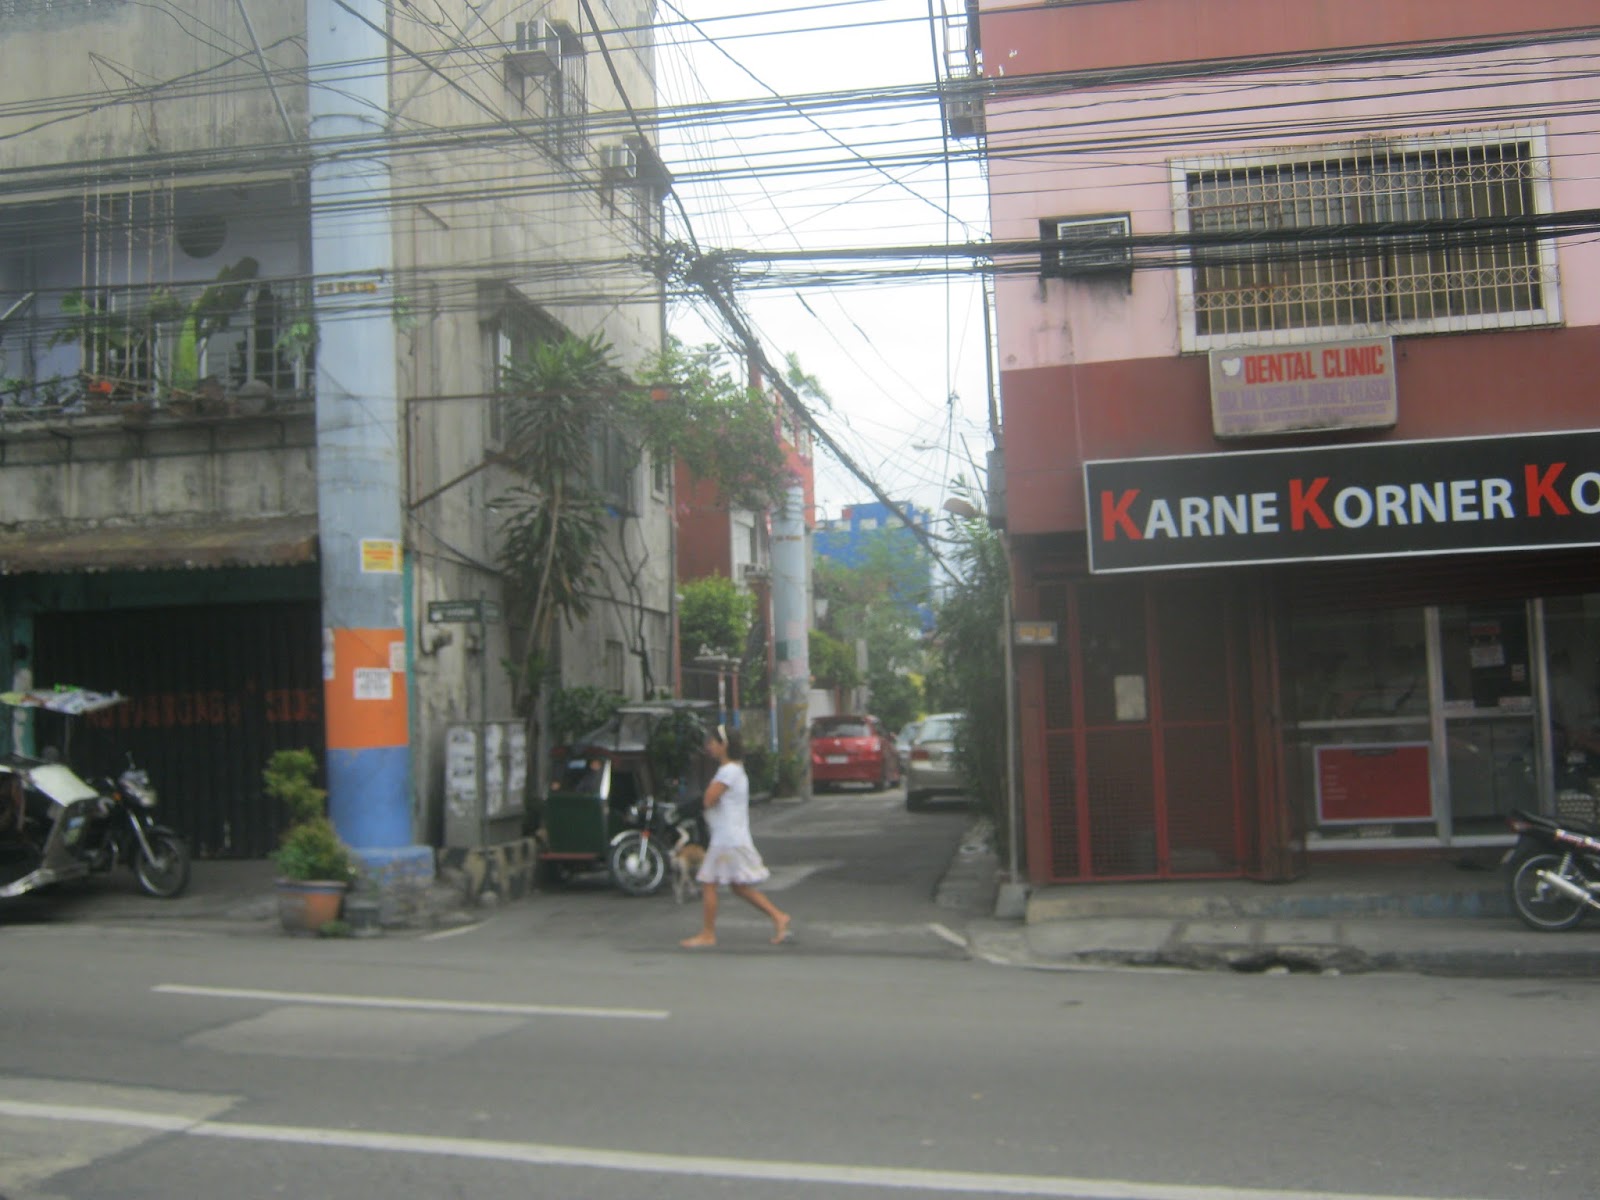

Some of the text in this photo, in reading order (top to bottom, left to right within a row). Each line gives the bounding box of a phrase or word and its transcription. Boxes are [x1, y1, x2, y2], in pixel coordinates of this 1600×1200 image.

[1244, 345, 1384, 384] DENTAL CLINIC
[1100, 488, 1280, 541] KARNE
[1289, 476, 1515, 531] KORNER
